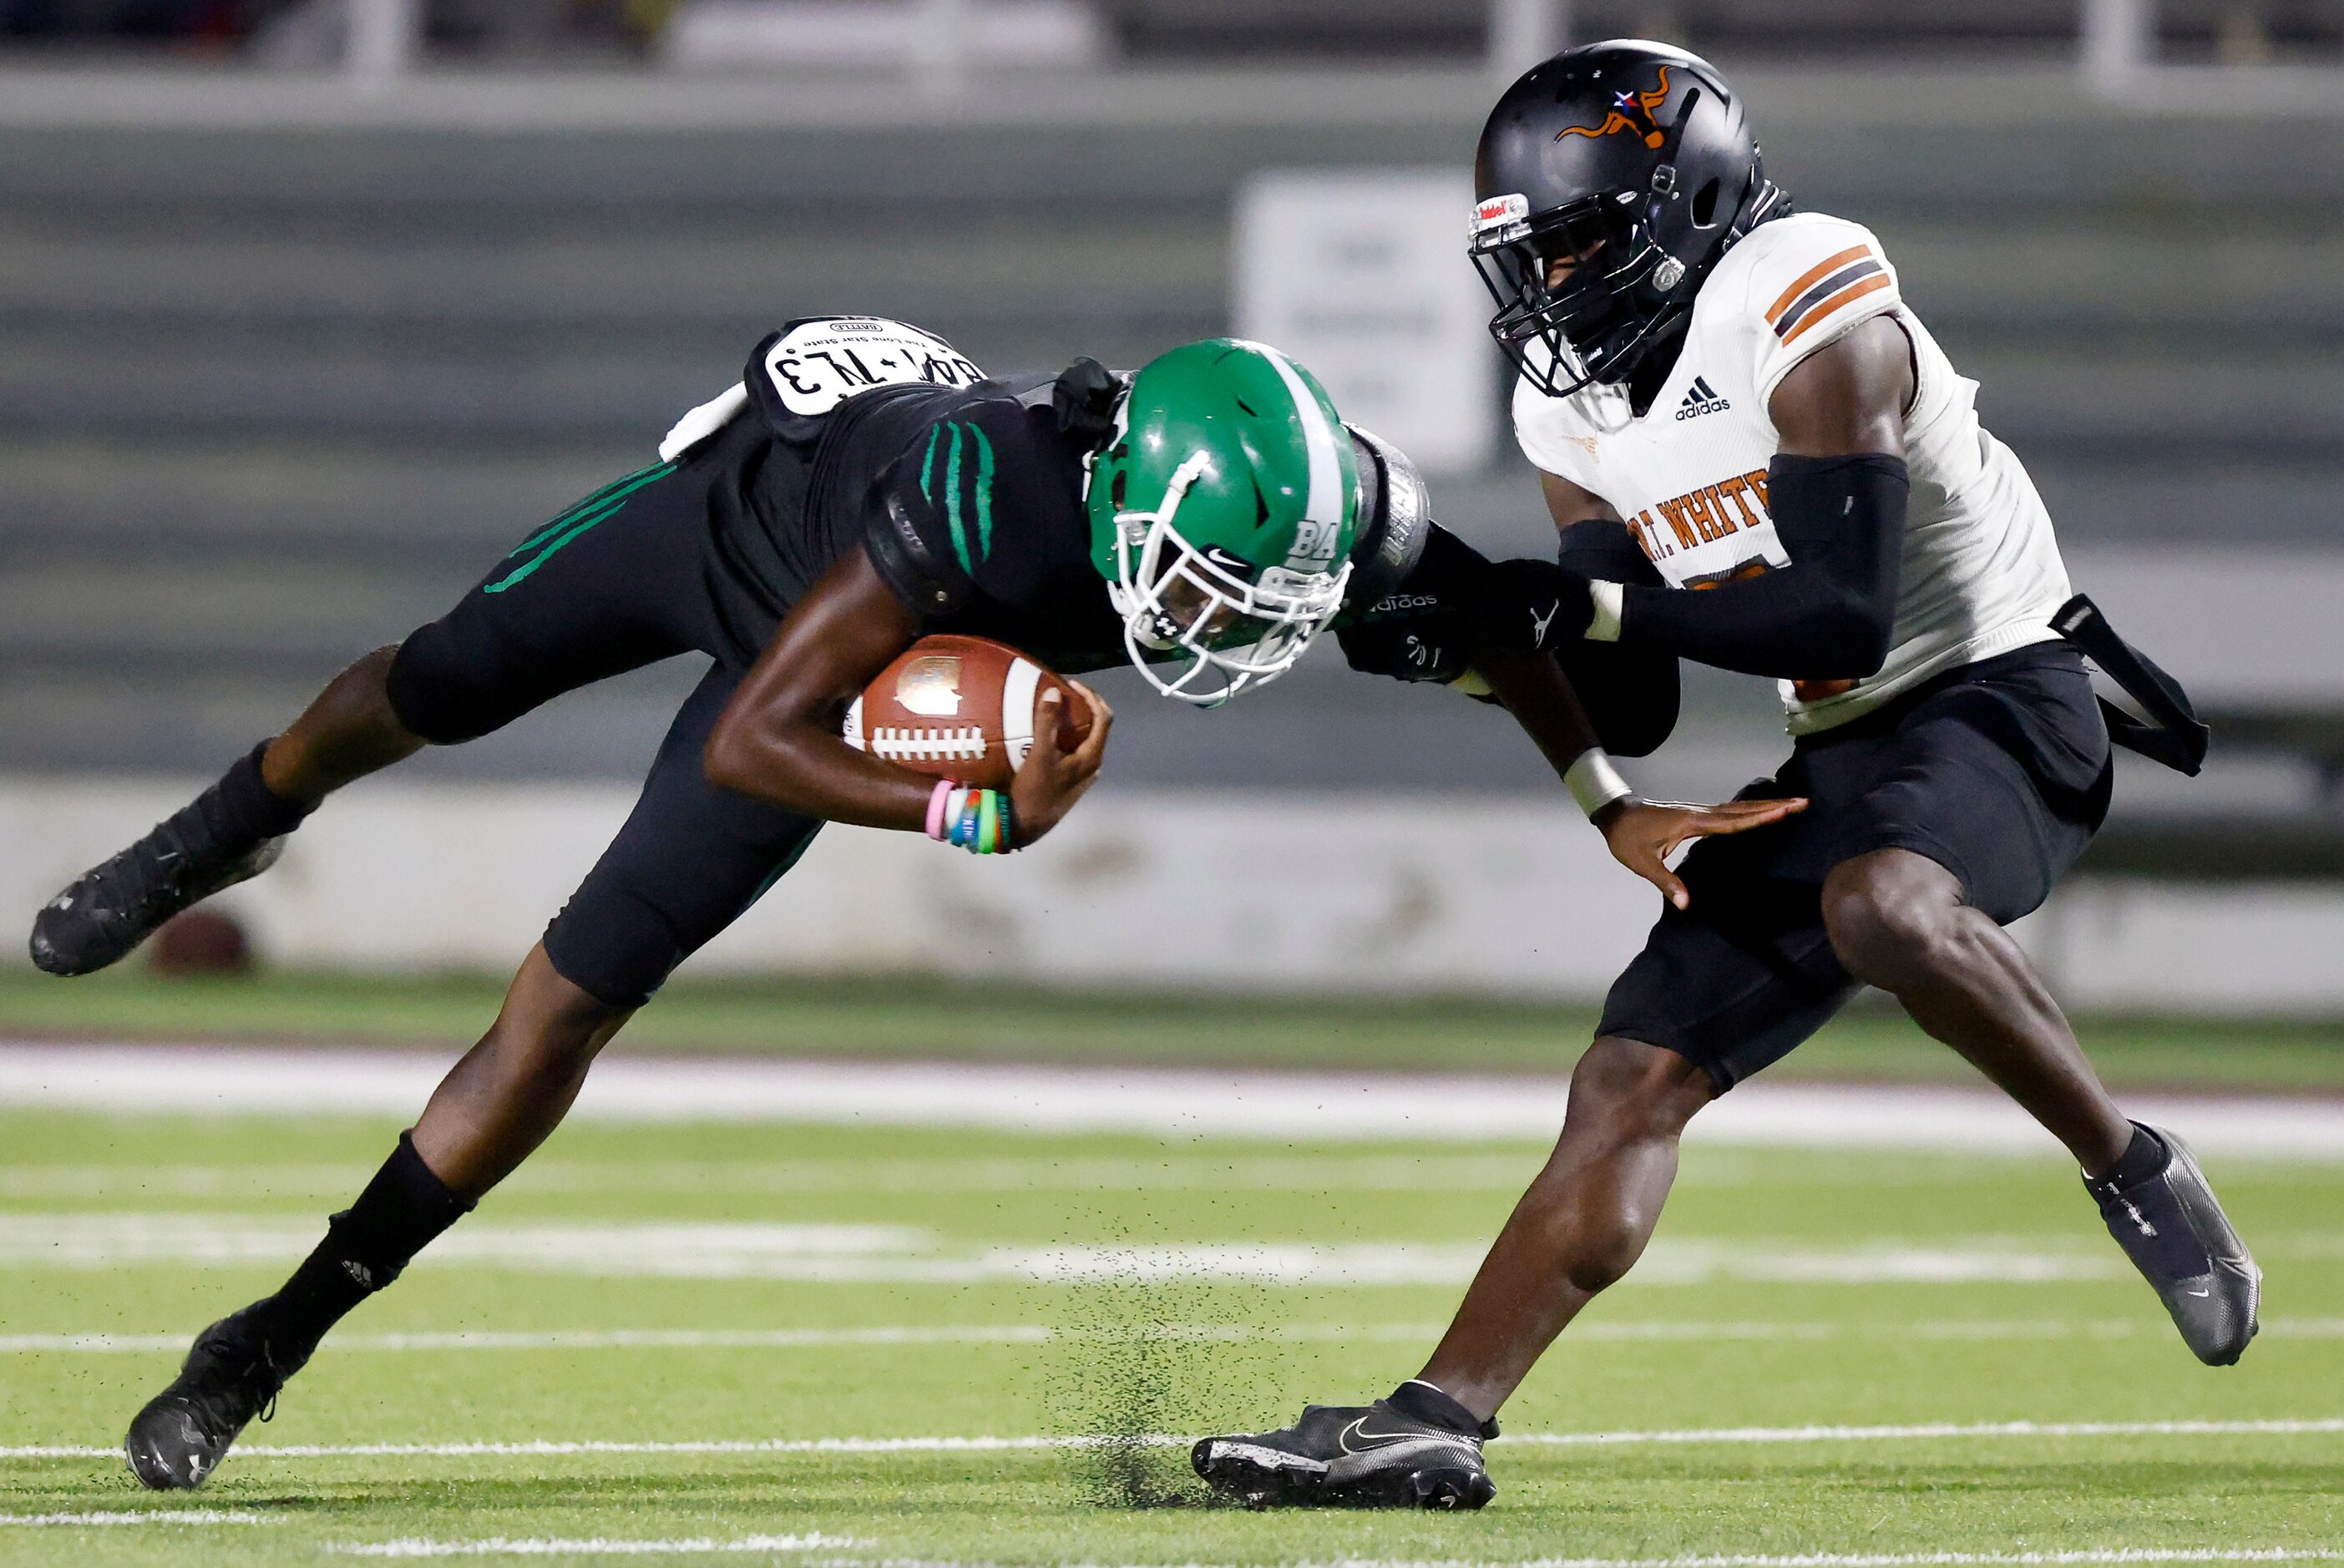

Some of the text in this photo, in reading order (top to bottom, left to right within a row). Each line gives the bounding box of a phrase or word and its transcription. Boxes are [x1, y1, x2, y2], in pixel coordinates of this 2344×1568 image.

[834, 323, 878, 331] BATTLE
[803, 336, 929, 348] The Lone Star State
[1675, 399, 1730, 421] adidas
[1288, 519, 1340, 561] BA
